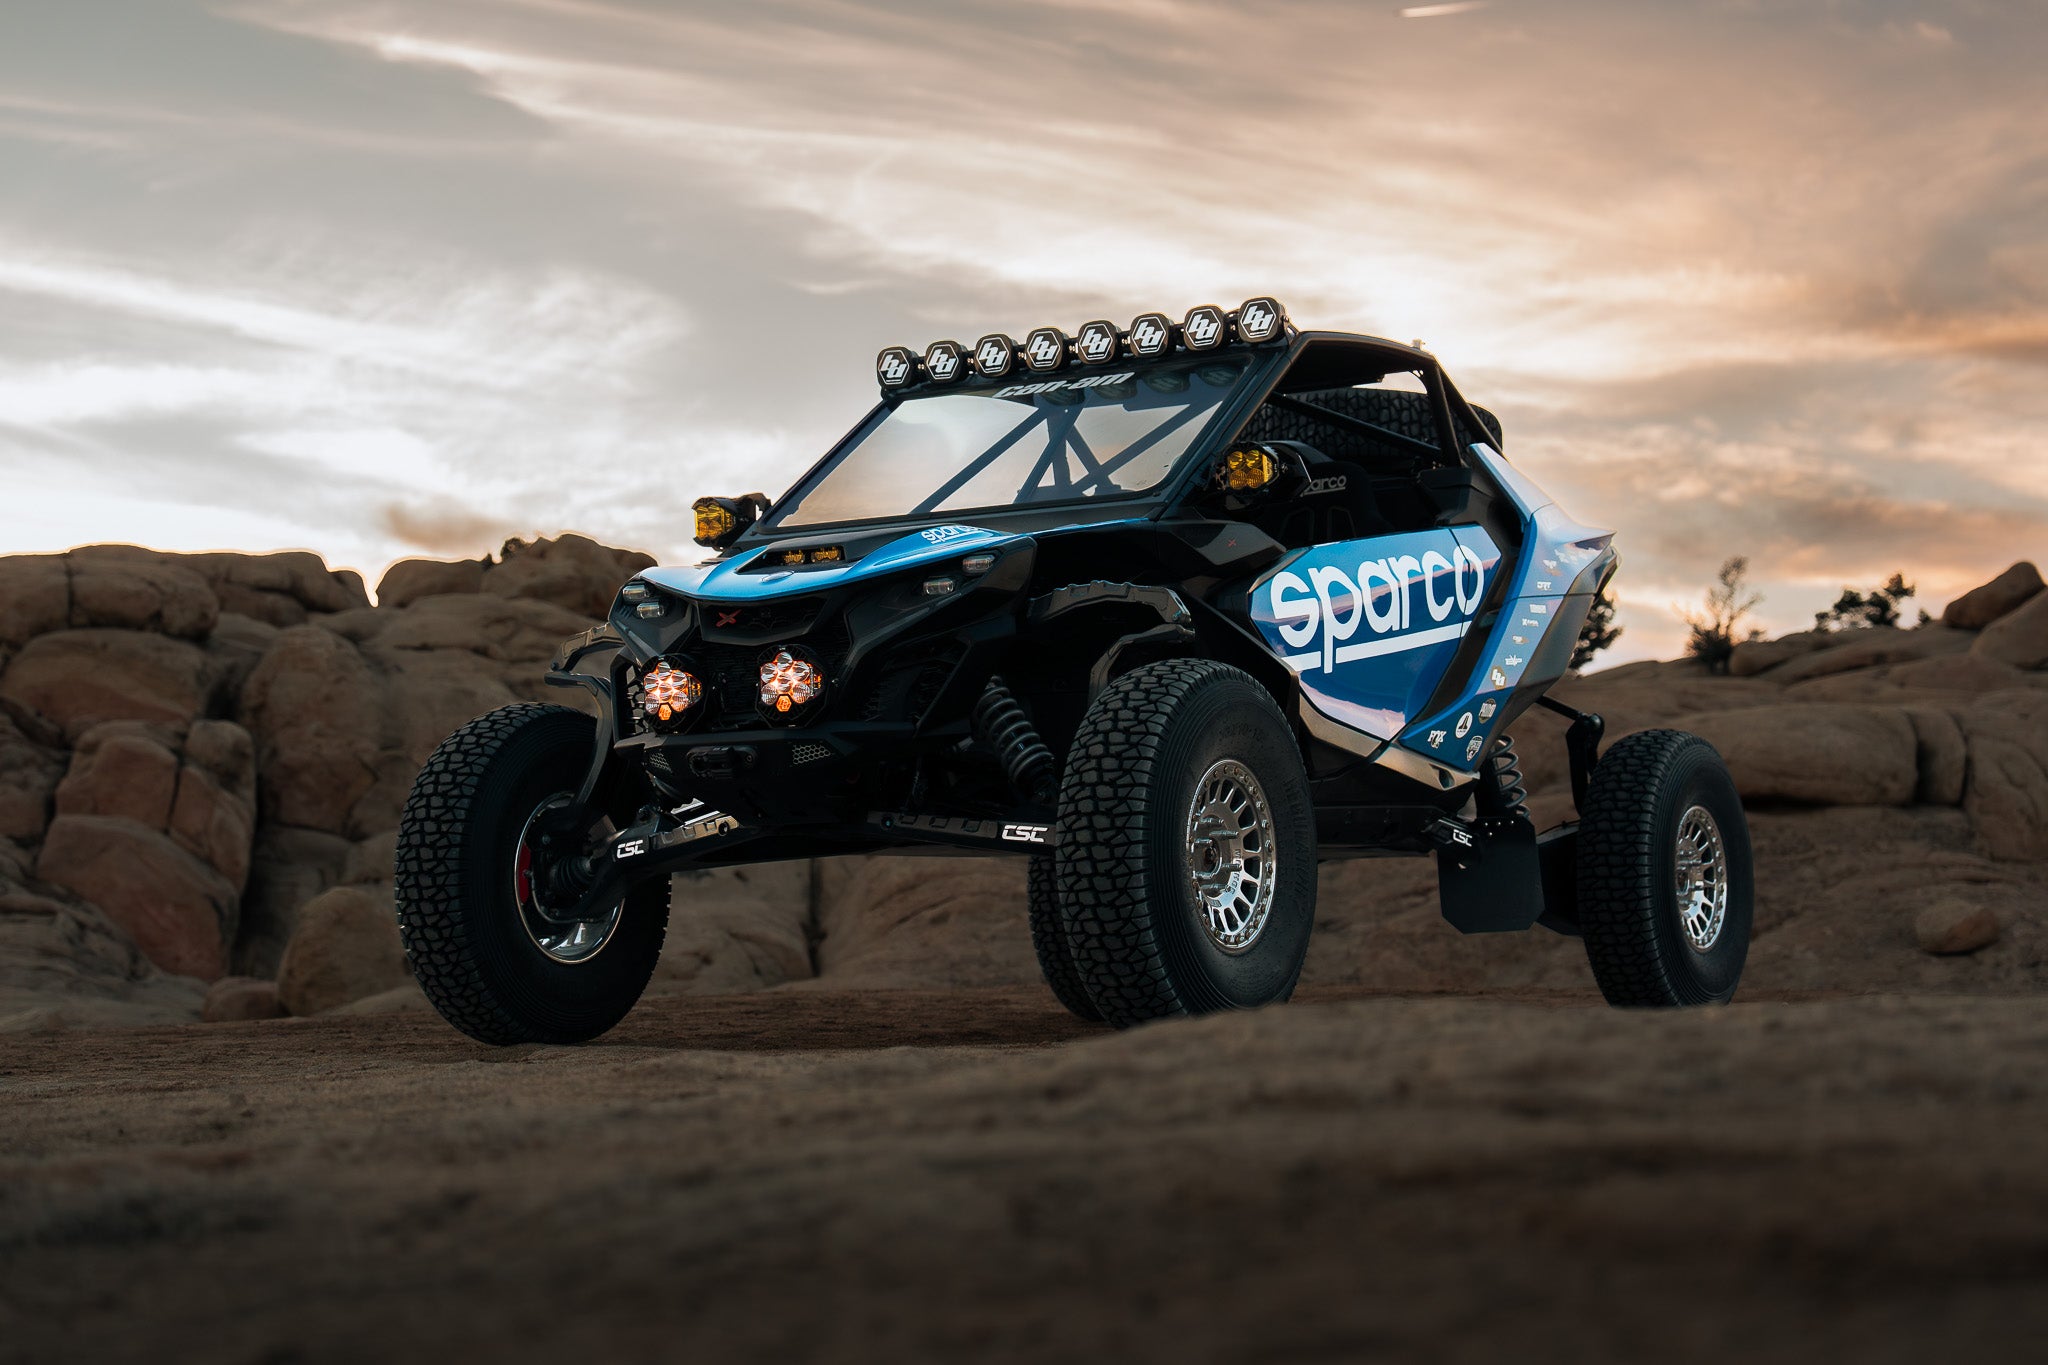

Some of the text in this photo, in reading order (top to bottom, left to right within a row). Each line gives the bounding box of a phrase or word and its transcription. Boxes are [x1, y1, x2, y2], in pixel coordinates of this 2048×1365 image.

[991, 371, 1136, 398] can-am
[1270, 544, 1485, 674] sparco
[1001, 824, 1049, 843] CSC
[1452, 828, 1473, 848] CSC
[616, 839, 645, 859] CSC
